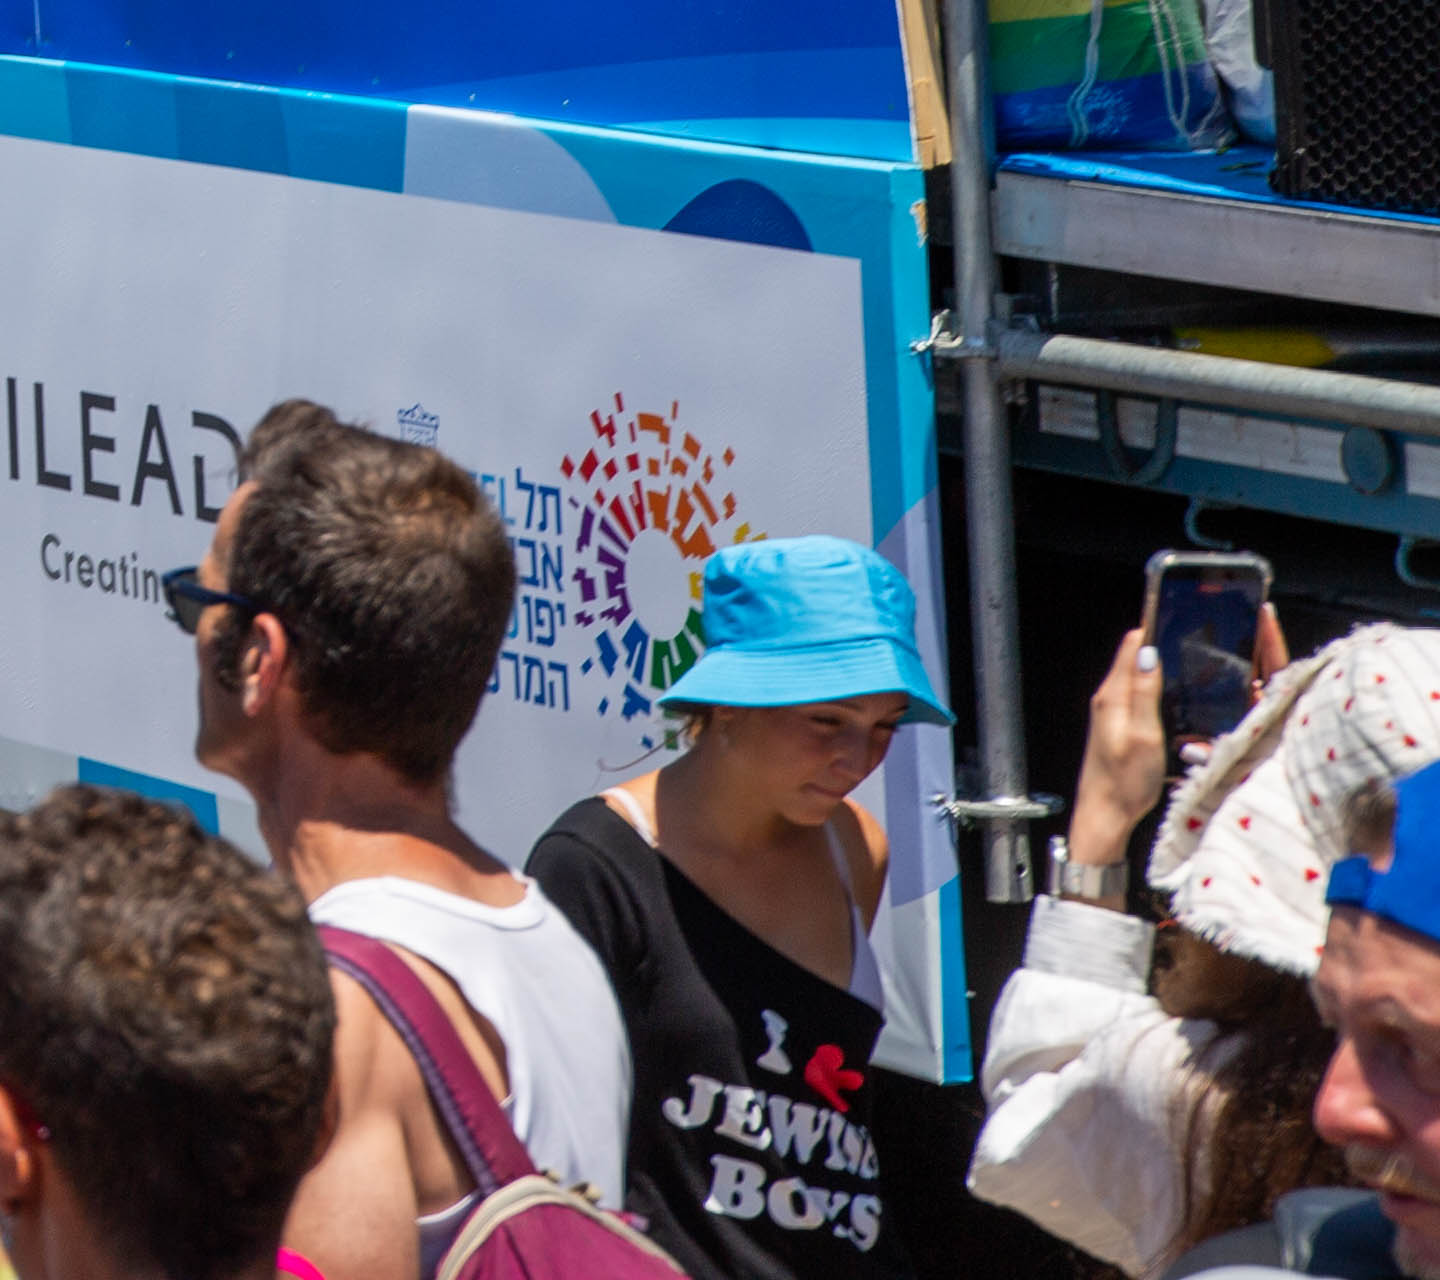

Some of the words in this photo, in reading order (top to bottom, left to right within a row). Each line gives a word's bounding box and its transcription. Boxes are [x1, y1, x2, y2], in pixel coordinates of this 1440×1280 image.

[516, 466, 563, 536] תל
[40, 533, 176, 622] Creatin
[510, 536, 565, 593] אב
[522, 595, 567, 648] יפו
[486, 650, 571, 712] המר
[756, 1008, 792, 1075] I
[702, 1153, 882, 1253] BOYS
